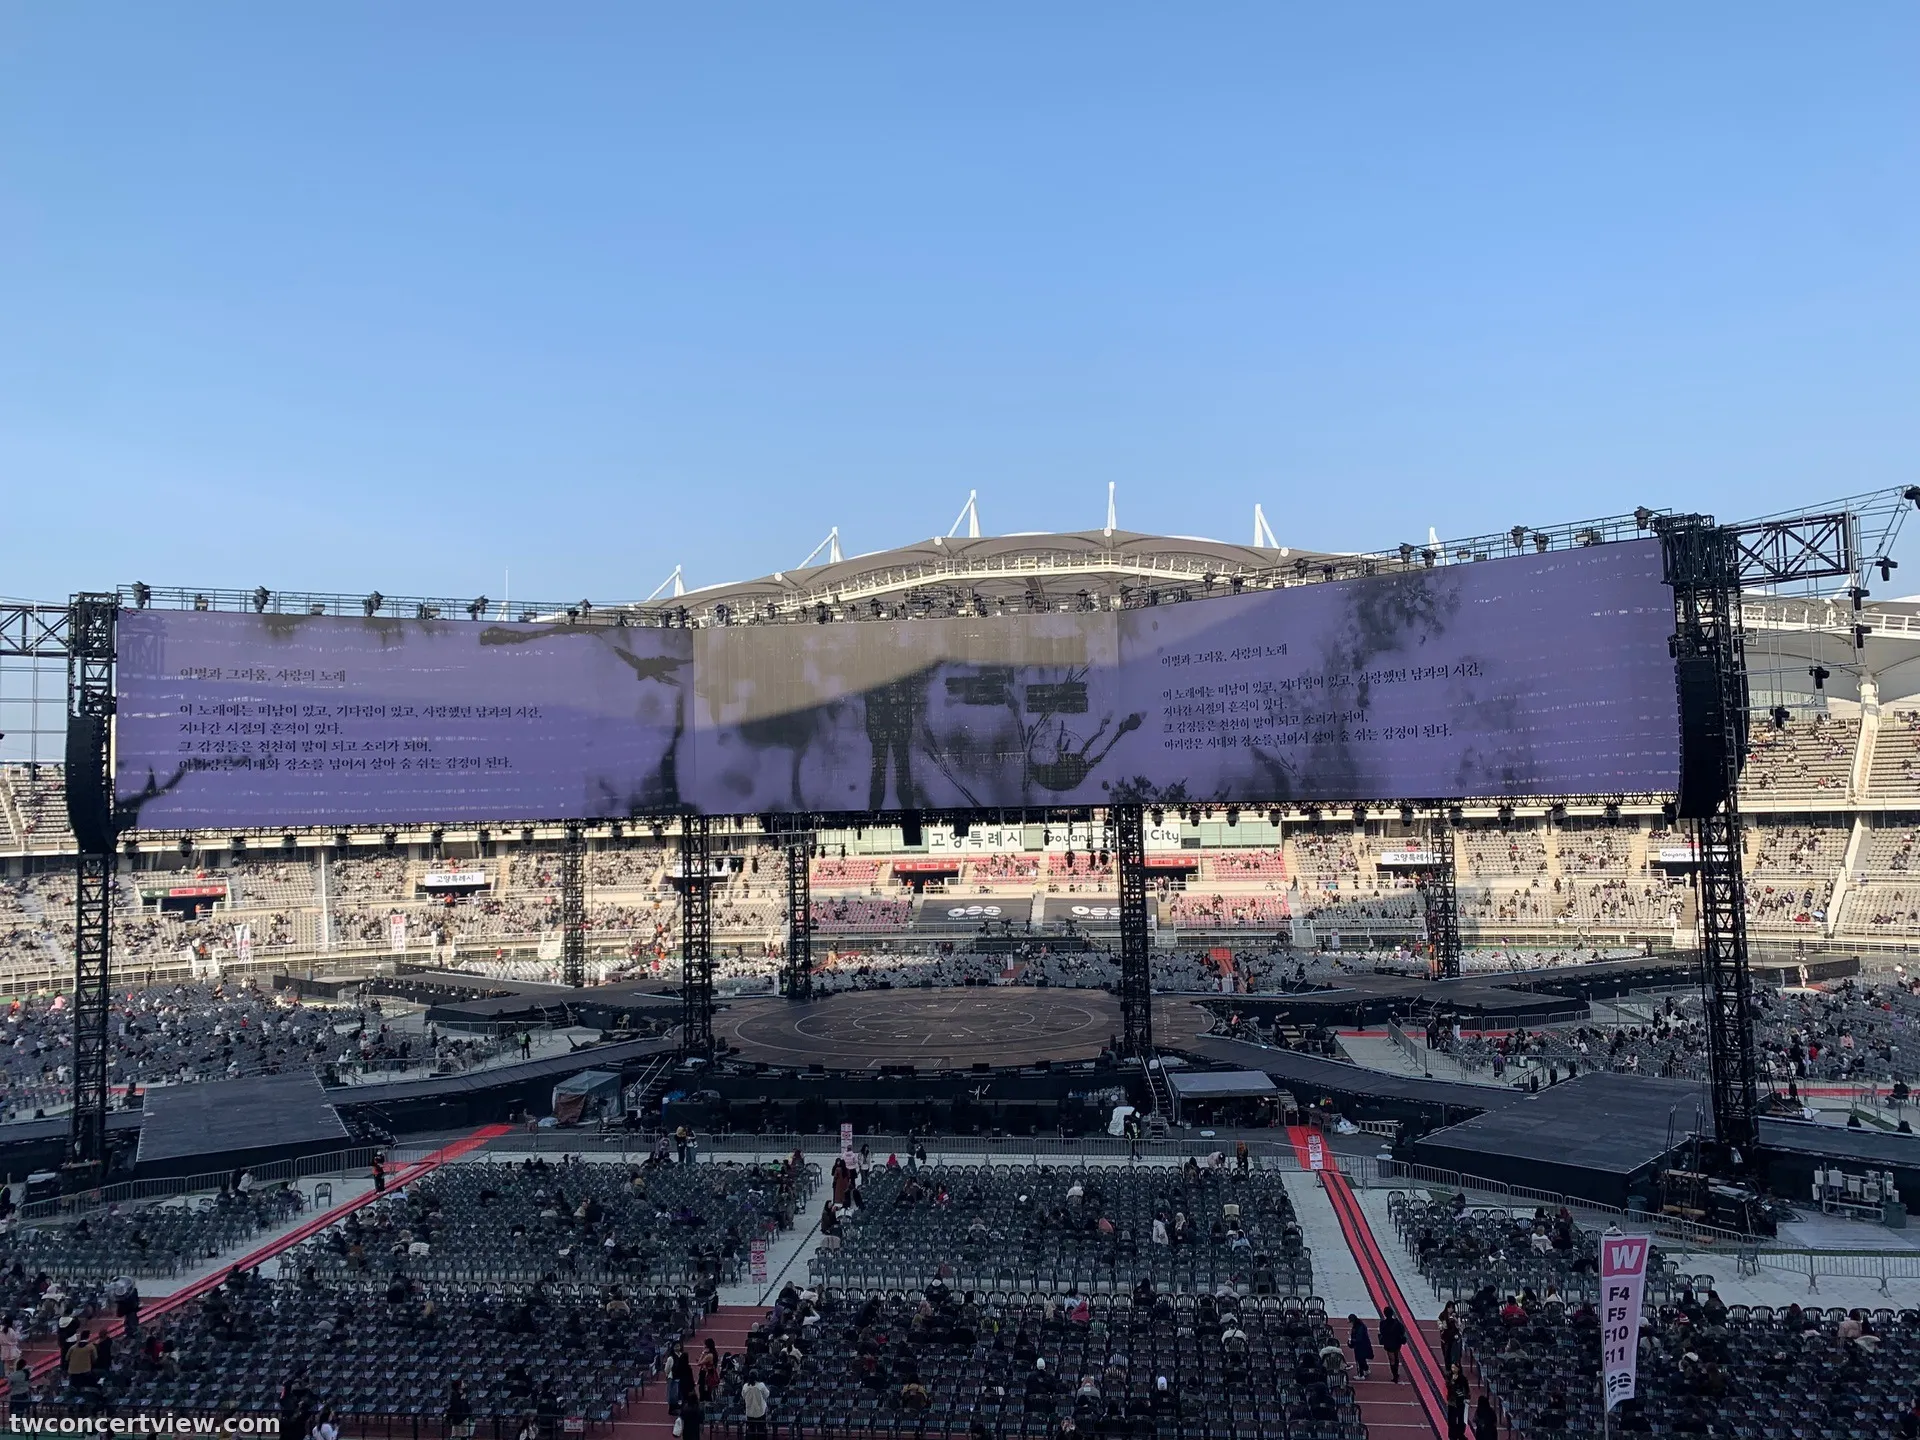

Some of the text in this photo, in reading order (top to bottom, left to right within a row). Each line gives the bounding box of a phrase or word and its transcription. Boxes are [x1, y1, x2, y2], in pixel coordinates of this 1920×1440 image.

[1161, 643, 1288, 667] 이별과 그리움, 사랑의 노래
[180, 667, 222, 680] 이별과
[275, 669, 315, 682] 사랑의
[319, 670, 346, 682] 노래
[1163, 689, 1172, 701] 이
[1175, 686, 1215, 699] 노래에는
[1253, 681, 1277, 695] 있고,
[1280, 675, 1324, 691] 기다림이
[1328, 674, 1354, 688] 있고,
[1358, 669, 1407, 685] 사랑했던
[1453, 662, 1483, 678] 시간,
[180, 704, 192, 716] 이
[197, 704, 253, 717] 노래에는
[336, 705, 386, 717] 기다림이
[423, 706, 471, 718] 사랑했던
[1163, 697, 1288, 717] 지나간 시절의 흔적이 있다.
[180, 722, 343, 735] 지나간 시절의 흔적이 있다.
[1163, 723, 1174, 734] 그
[1176, 720, 1216, 734] 감정들은
[1219, 717, 1250, 732] 천천히
[1278, 714, 1300, 728] 되고
[1304, 711, 1337, 725] 소리가
[1164, 723, 1453, 751] 아리랑은 시대와 장소를 넘어서 살아 숨 쉬는 감정이 된다.
[178, 741, 193, 752] 그
[198, 740, 252, 753] 감정들은
[258, 740, 296, 753] 천천히
[302, 740, 327, 753] 말이
[331, 740, 357, 752] 되고
[361, 740, 398, 752] 소리가
[240, 758, 280, 771] 시대와
[285, 758, 324, 771] 장소를
[329, 757, 366, 770] 넘어서
[370, 757, 396, 770] 살아
[400, 757, 412, 770] 숨
[416, 757, 441, 770] 쉬는
[445, 757, 481, 769] 감정이
[484, 756, 513, 769] 된다.
[1151, 829, 1179, 844] City
[1661, 851, 1687, 860] Goyang
[436, 875, 474, 884] 고양특례시
[1612, 1245, 1641, 1270] W
[1609, 1287, 1630, 1301] F4
[1608, 1307, 1626, 1322] F5
[1605, 1325, 1629, 1345] F10
[1605, 1347, 1625, 1366] F11
